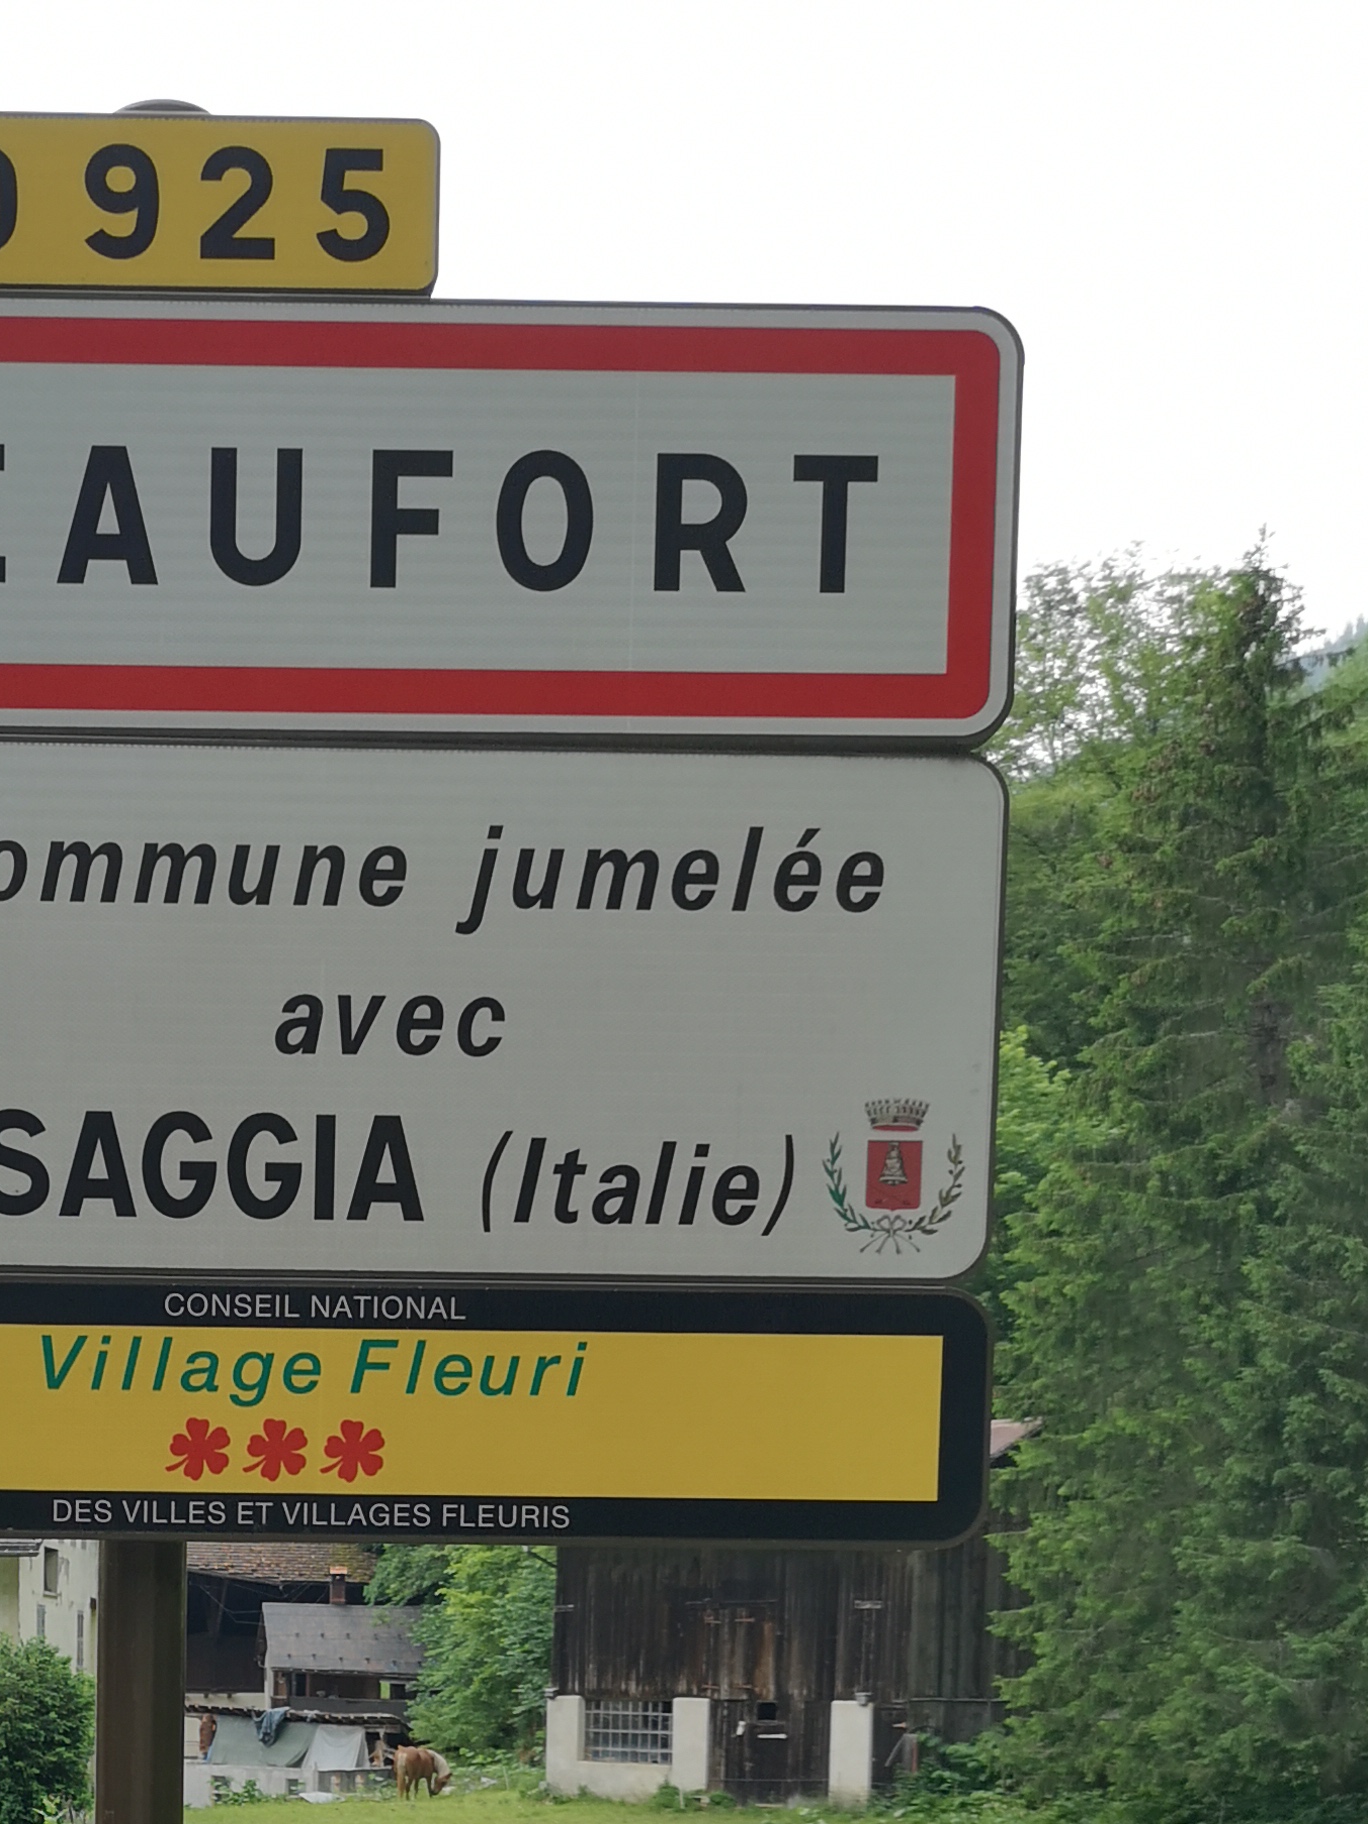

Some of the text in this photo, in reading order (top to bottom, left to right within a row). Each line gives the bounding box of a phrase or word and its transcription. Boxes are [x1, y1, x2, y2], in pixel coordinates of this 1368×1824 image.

[84, 143, 391, 263] 925
[454, 824, 885, 935] jumelée
[274, 993, 506, 1058] avec
[481, 1130, 795, 1237] (Italie)
[164, 1293, 466, 1320] CONSEIL NATIONAL
[41, 1335, 587, 1407] Village Fleuri
[52, 1499, 571, 1529] DES VILLES ET VILLAGES FLEURIS
